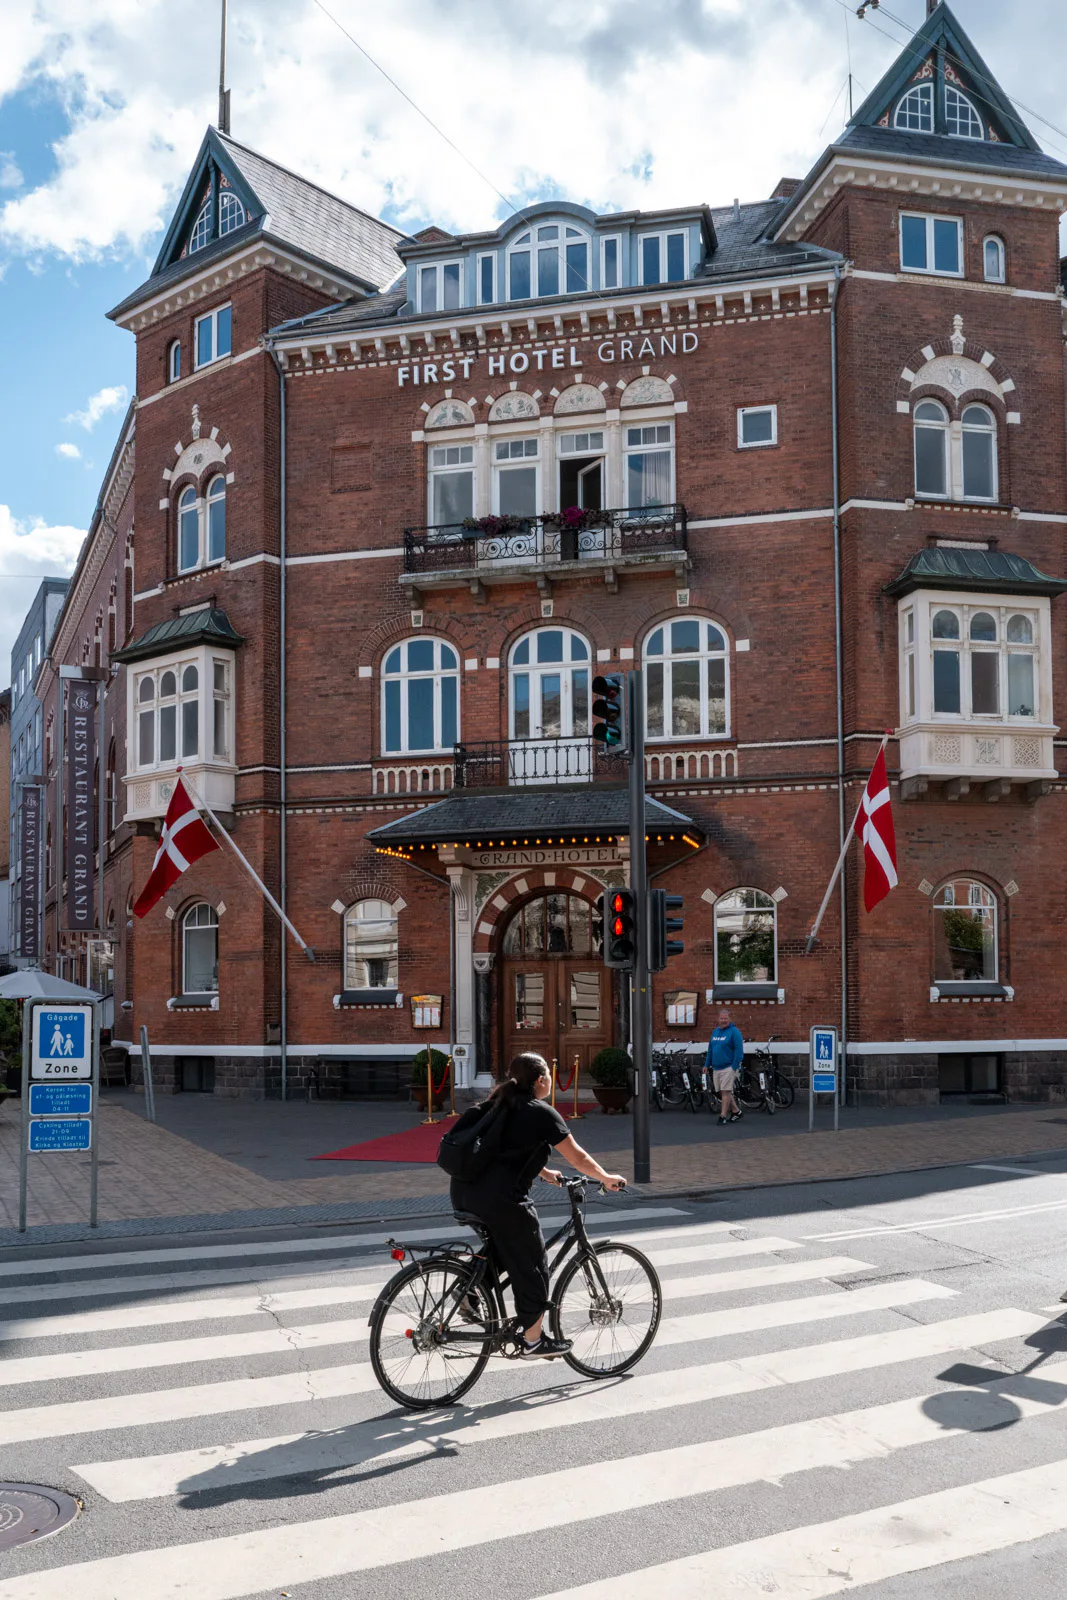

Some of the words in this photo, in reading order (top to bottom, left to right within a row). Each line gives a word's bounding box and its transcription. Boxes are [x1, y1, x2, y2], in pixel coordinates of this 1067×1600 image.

[397, 357, 475, 387] FIRST
[488, 346, 583, 376] HOTEL
[597, 332, 699, 363] GRAND
[73, 716, 88, 845] RESTAURANT
[25, 811, 36, 901] RESTAURANT
[73, 854, 88, 921] GRAND
[25, 907, 34, 955] GRAND
[45, 1063, 78, 1074] Zone
